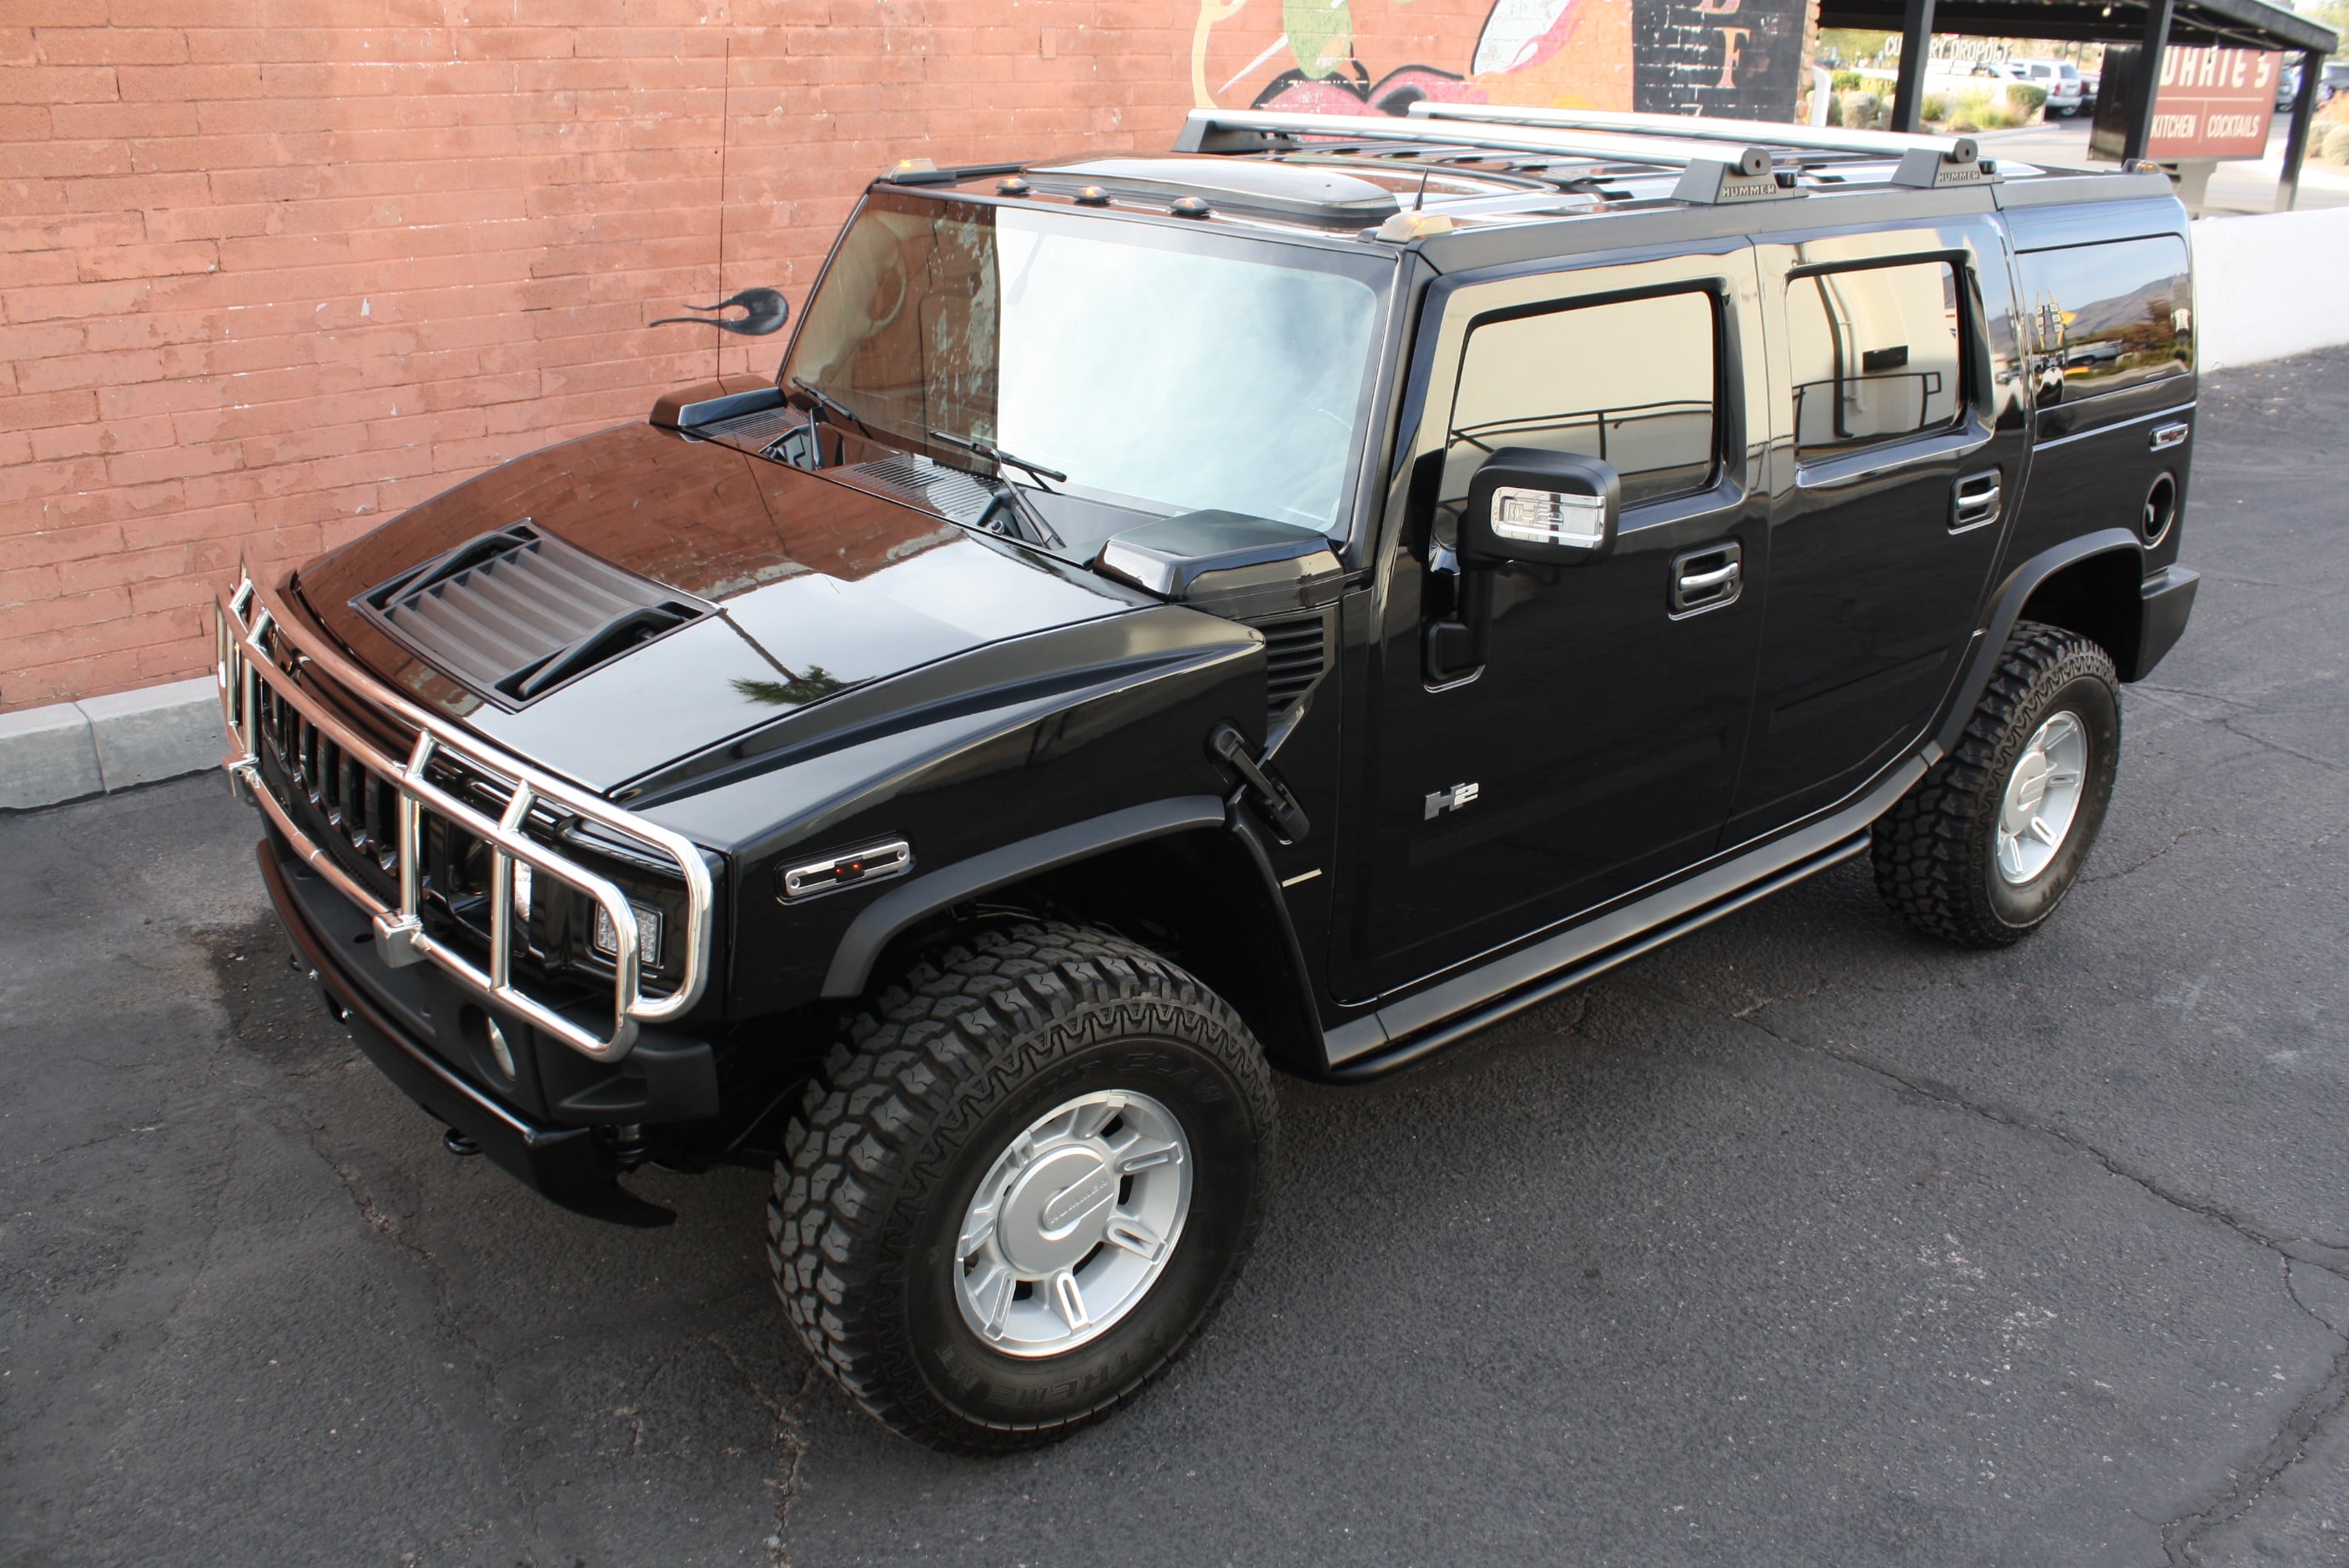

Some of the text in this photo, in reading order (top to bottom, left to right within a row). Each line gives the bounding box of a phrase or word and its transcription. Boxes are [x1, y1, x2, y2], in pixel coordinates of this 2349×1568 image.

[2150, 113, 2261, 138] KITCHEN COCKTAILS
[1939, 170, 1980, 183] HUMMER
[1722, 184, 1777, 198] HUMMER
[1424, 781, 1480, 822] H2
